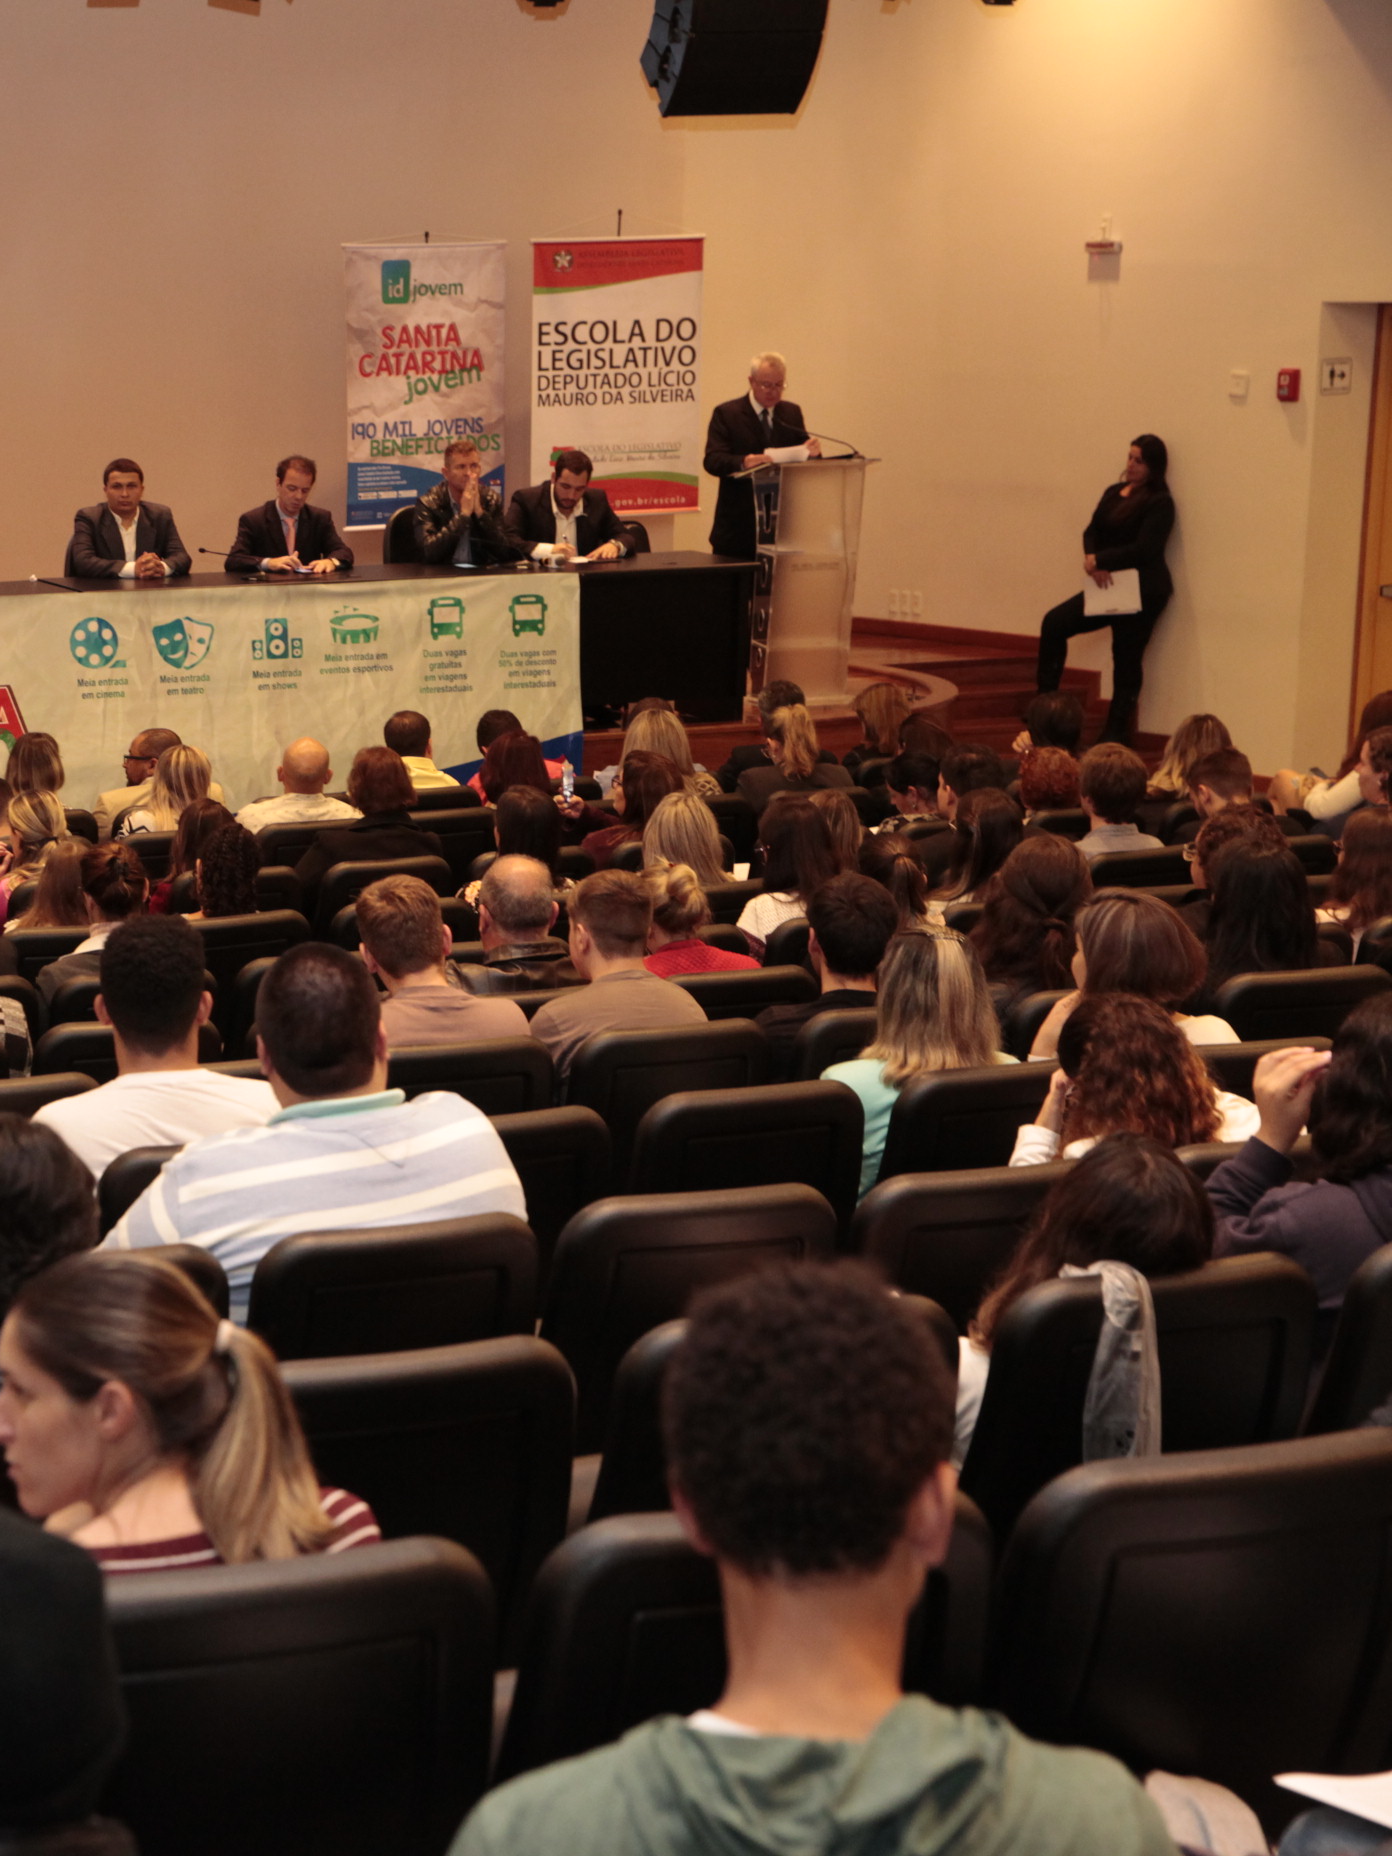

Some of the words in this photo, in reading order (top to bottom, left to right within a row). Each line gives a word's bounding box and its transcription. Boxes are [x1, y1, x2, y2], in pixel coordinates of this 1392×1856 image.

[387, 277, 404, 298] id
[411, 279, 464, 304] jovem
[381, 322, 462, 350] SANTA
[537, 319, 646, 346] ESCOLA
[655, 317, 697, 342] DO
[358, 347, 485, 378] CATARINA
[537, 345, 697, 372] LEGISLATIVO
[537, 371, 642, 392] DEPUTADO
[647, 367, 696, 388] LÍCIO
[403, 365, 482, 405] jovem
[537, 392, 598, 408] MAURO
[602, 391, 624, 405] DA
[628, 388, 696, 405] SILVEIRA
[351, 422, 377, 440] 190
[383, 420, 416, 438] MIL
[423, 416, 484, 437] JOVENS
[628, 442, 682, 451] LEGISLATIVO
[611, 496, 686, 508] .gov.br/escola
[324, 653, 343, 662] Meia
[344, 652, 374, 662] entrada
[376, 652, 388, 660] em
[422, 649, 443, 658] Duas
[444, 648, 467, 659] vagas
[500, 650, 518, 658] Duas
[519, 650, 540, 659] vagas
[429, 660, 462, 672] gratuitas
[515, 659, 524, 667] de
[525, 658, 557, 667] desconto
[252, 670, 271, 679] Meia
[272, 669, 302, 678] entrada
[319, 666, 350, 675] eventos
[352, 664, 394, 674] esportivos
[521, 669, 551, 678] viagens
[77, 678, 96, 687] Meia
[98, 677, 129, 686] entrada
[159, 675, 179, 684] Meia
[180, 674, 211, 683] entrada
[438, 673, 468, 683] viagens
[258, 683, 270, 691] em
[272, 682, 298, 690] shows
[419, 684, 473, 694] interestaduais
[503, 680, 557, 689] interestaduais
[82, 692, 94, 700] em
[96, 690, 125, 699] cinema
[166, 688, 179, 696] em
[181, 686, 205, 695] teatro
